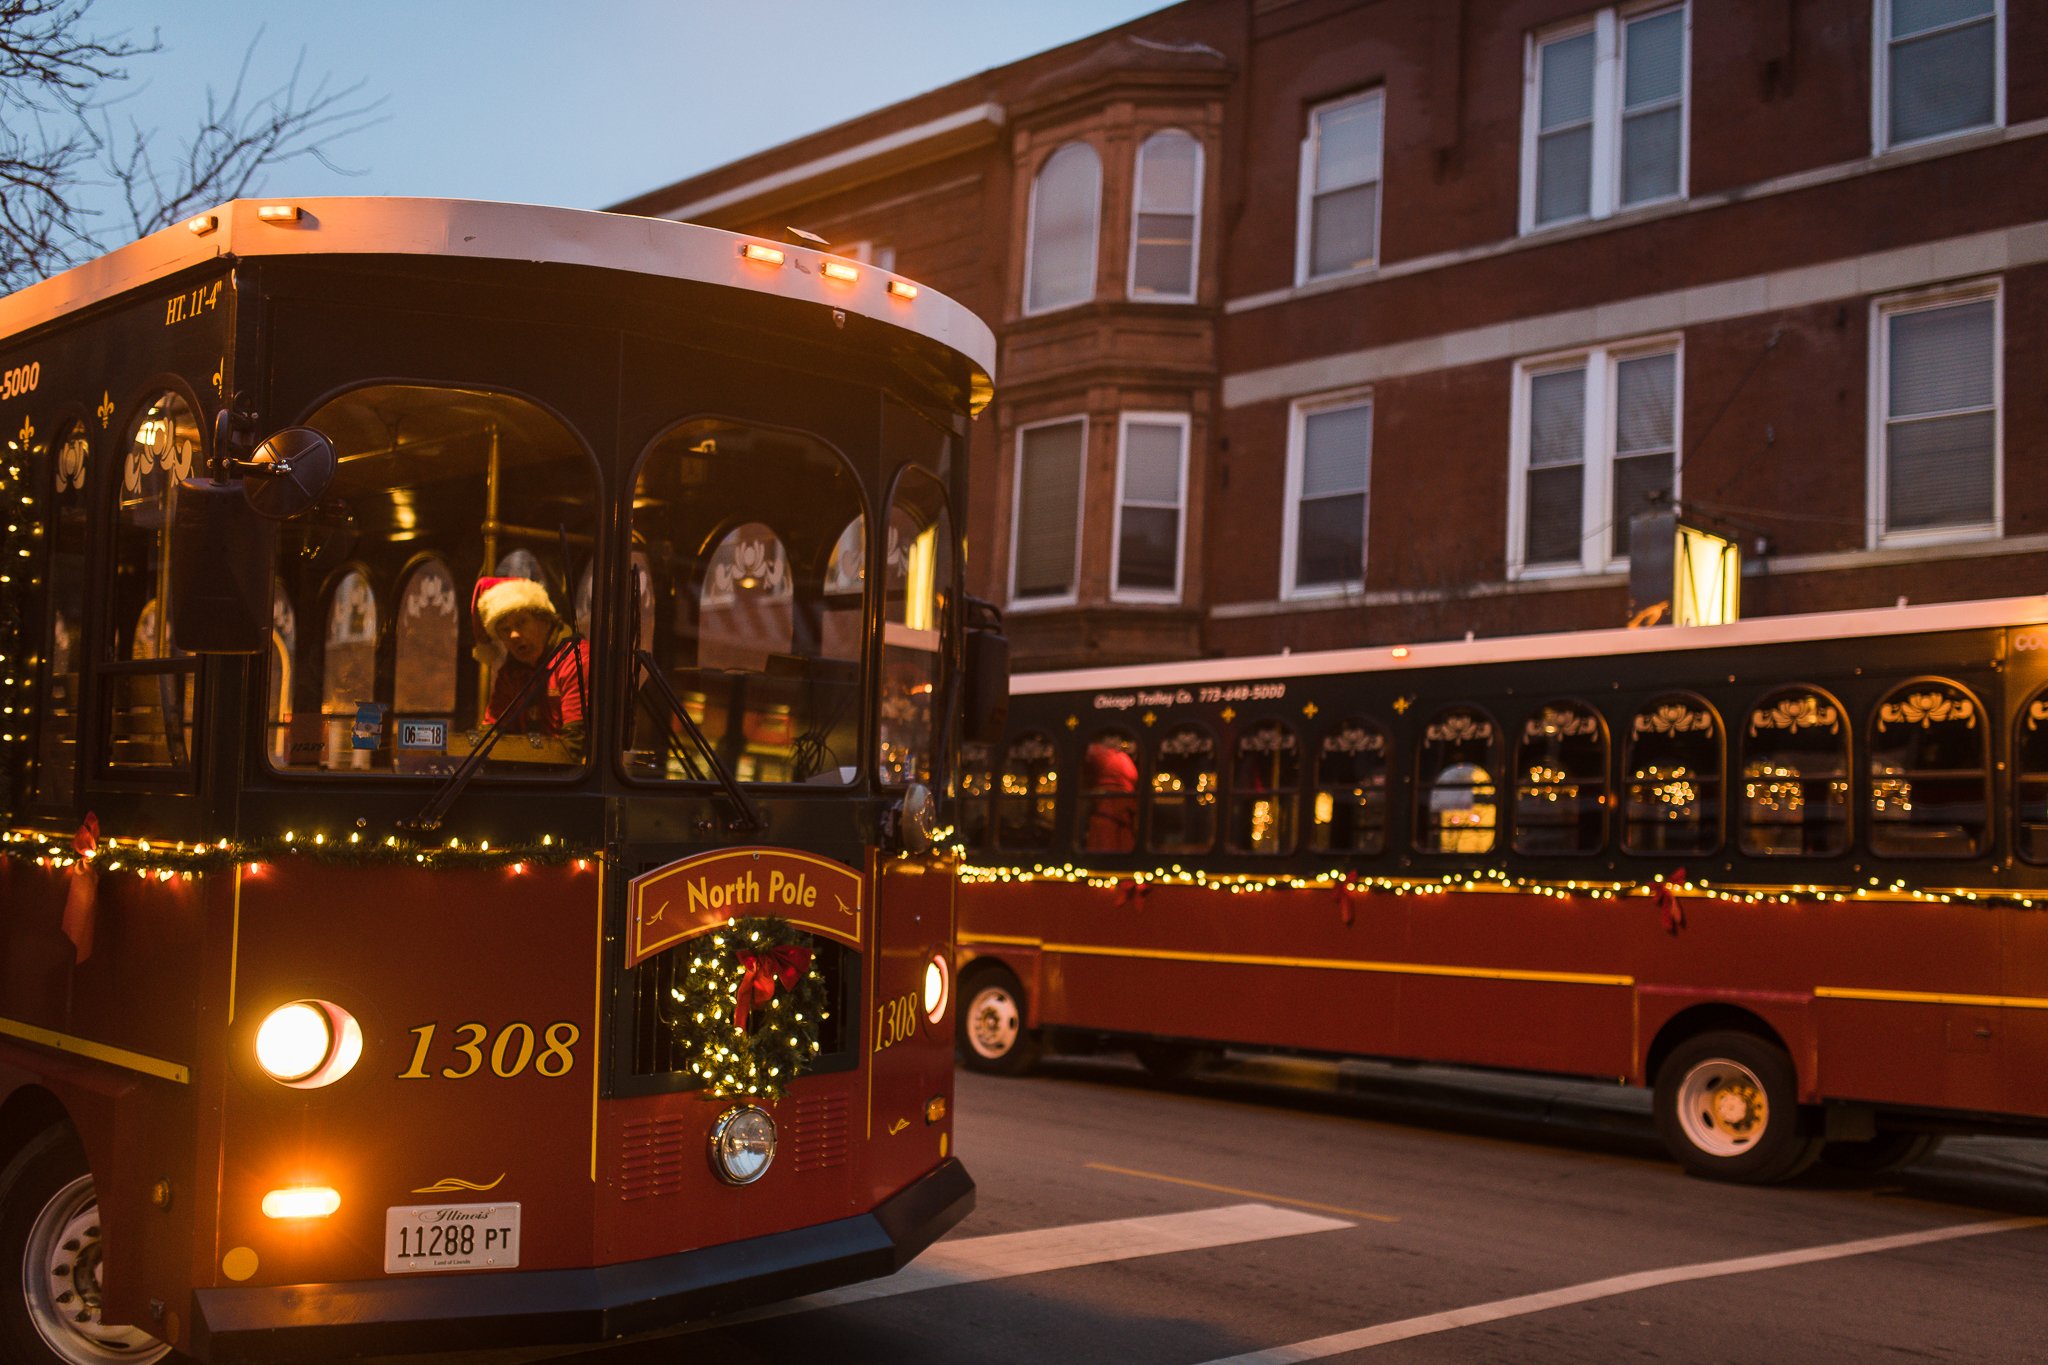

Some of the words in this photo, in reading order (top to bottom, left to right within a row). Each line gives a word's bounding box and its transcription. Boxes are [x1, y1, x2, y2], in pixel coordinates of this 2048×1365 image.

[165, 294, 187, 326] HT.
[1093, 693, 1136, 710] Chicago
[1137, 690, 1176, 707] Trolley
[404, 725, 416, 744] 06
[431, 726, 442, 745] 18
[687, 870, 760, 913] North
[768, 870, 817, 908] Pole
[873, 991, 918, 1053] 1308
[397, 1022, 580, 1079] 1308
[419, 1207, 490, 1222] Illinois
[397, 1224, 475, 1258] 11288
[485, 1227, 512, 1250] PT
